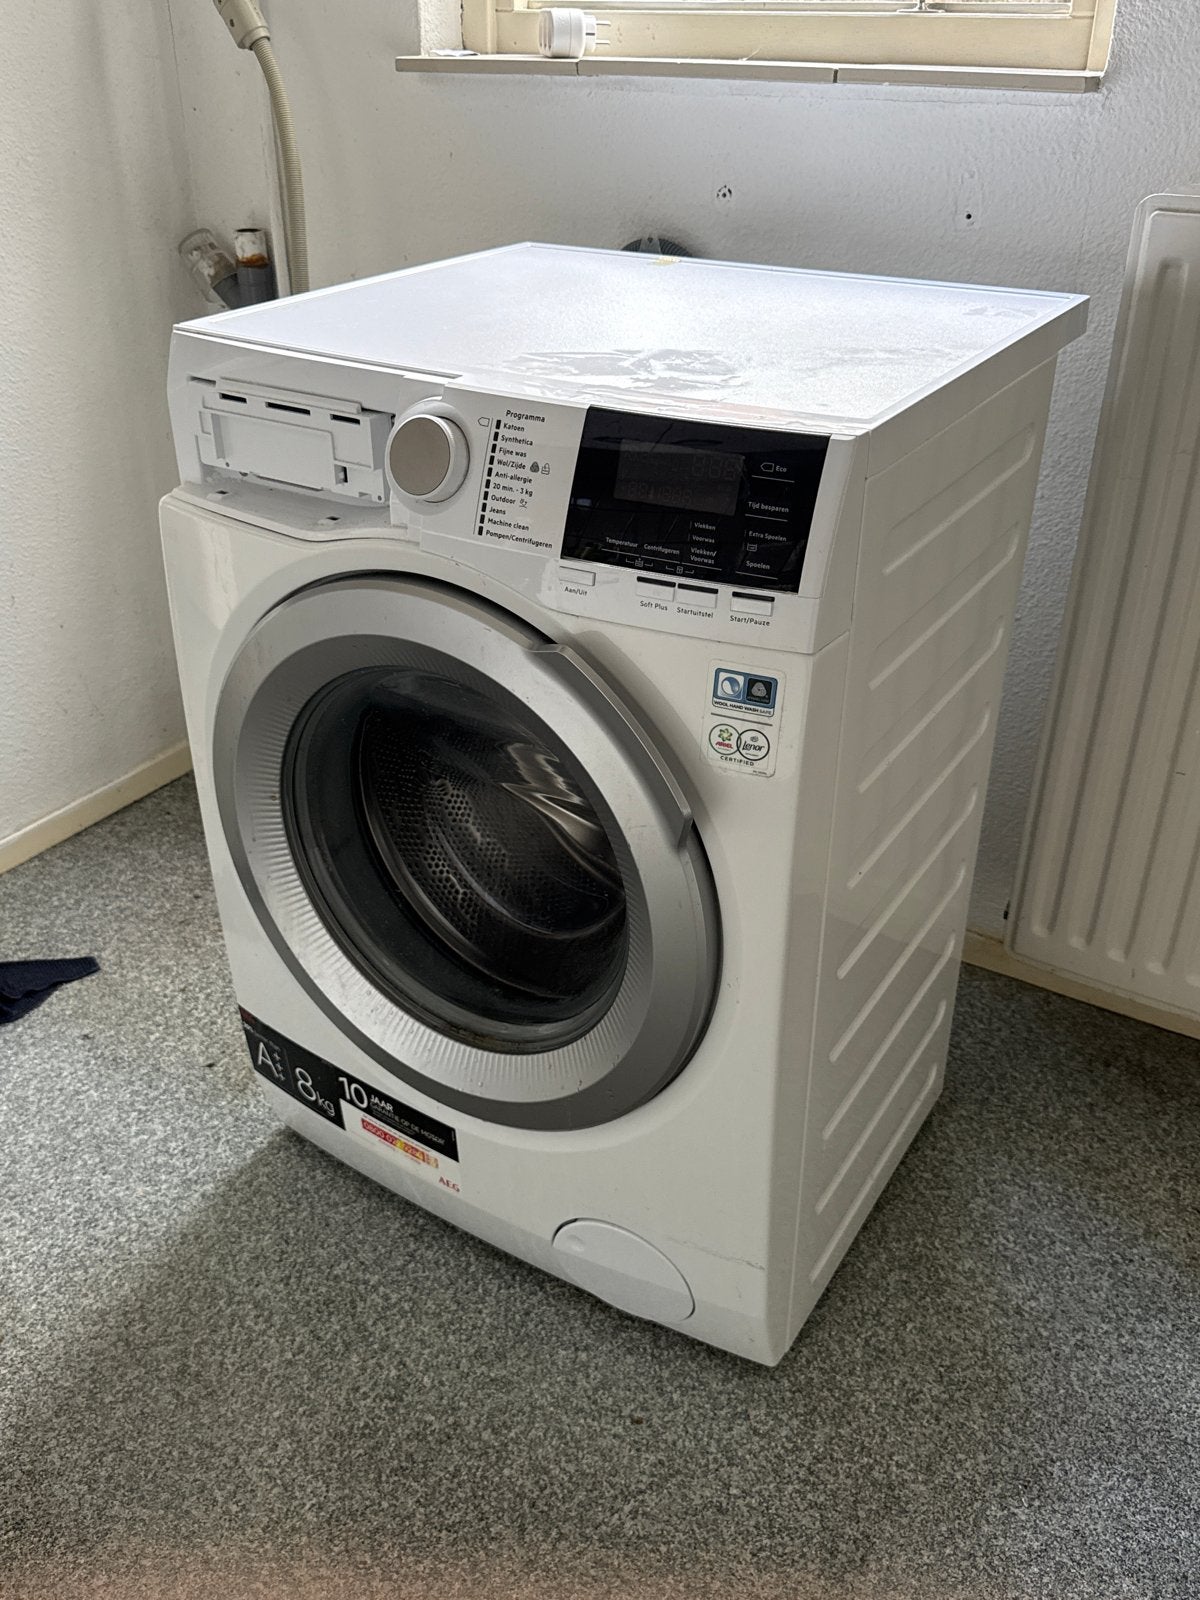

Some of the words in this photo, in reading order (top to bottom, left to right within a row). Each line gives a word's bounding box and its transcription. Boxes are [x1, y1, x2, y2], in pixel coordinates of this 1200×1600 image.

[506, 410, 546, 422] Programma
[503, 422, 525, 432] Katoen
[500, 434, 534, 446] Synthetica
[498, 447, 514, 456] Fijne
[515, 450, 527, 458] was
[496, 458, 527, 470] Wol/Zijde
[775, 464, 787, 473] Eco
[494, 471, 533, 484] Anti-allergie
[492, 482, 501, 490] 20
[502, 485, 514, 493] min.
[520, 487, 525, 495] 3
[525, 489, 533, 498] kg
[491, 494, 516, 505] Outdoor
[489, 506, 506, 515] Jeans
[748, 501, 760, 511] Tijd
[761, 503, 789, 514] besparen
[487, 517, 512, 528] Machine
[513, 522, 530, 532] clean
[694, 522, 716, 531] Vlekken
[485, 529, 553, 549] Pompen/Centrifugeren
[692, 534, 715, 543] Voorwas
[748, 530, 764, 539] Extra
[764, 533, 787, 542] Spoelen
[606, 536, 639, 548] Temperatuur
[643, 543, 680, 555] Centrifugeren
[690, 554, 715, 565] Voorwas
[746, 560, 771, 570] Spoelen
[564, 586, 588, 596] Aan/Uit
[639, 600, 653, 608] Soft
[654, 602, 668, 611] Plus
[676, 606, 714, 618] Startuitstel
[729, 615, 771, 627] Start/Pauze
[729, 703, 744, 711] HAND
[744, 705, 759, 713] WASH
[742, 740, 765, 752] Lenor
[719, 755, 755, 767] CERTIFIED
[338, 1076, 368, 1109] 10
[370, 1094, 394, 1113] JAAR
[438, 1176, 460, 1193] AEG
